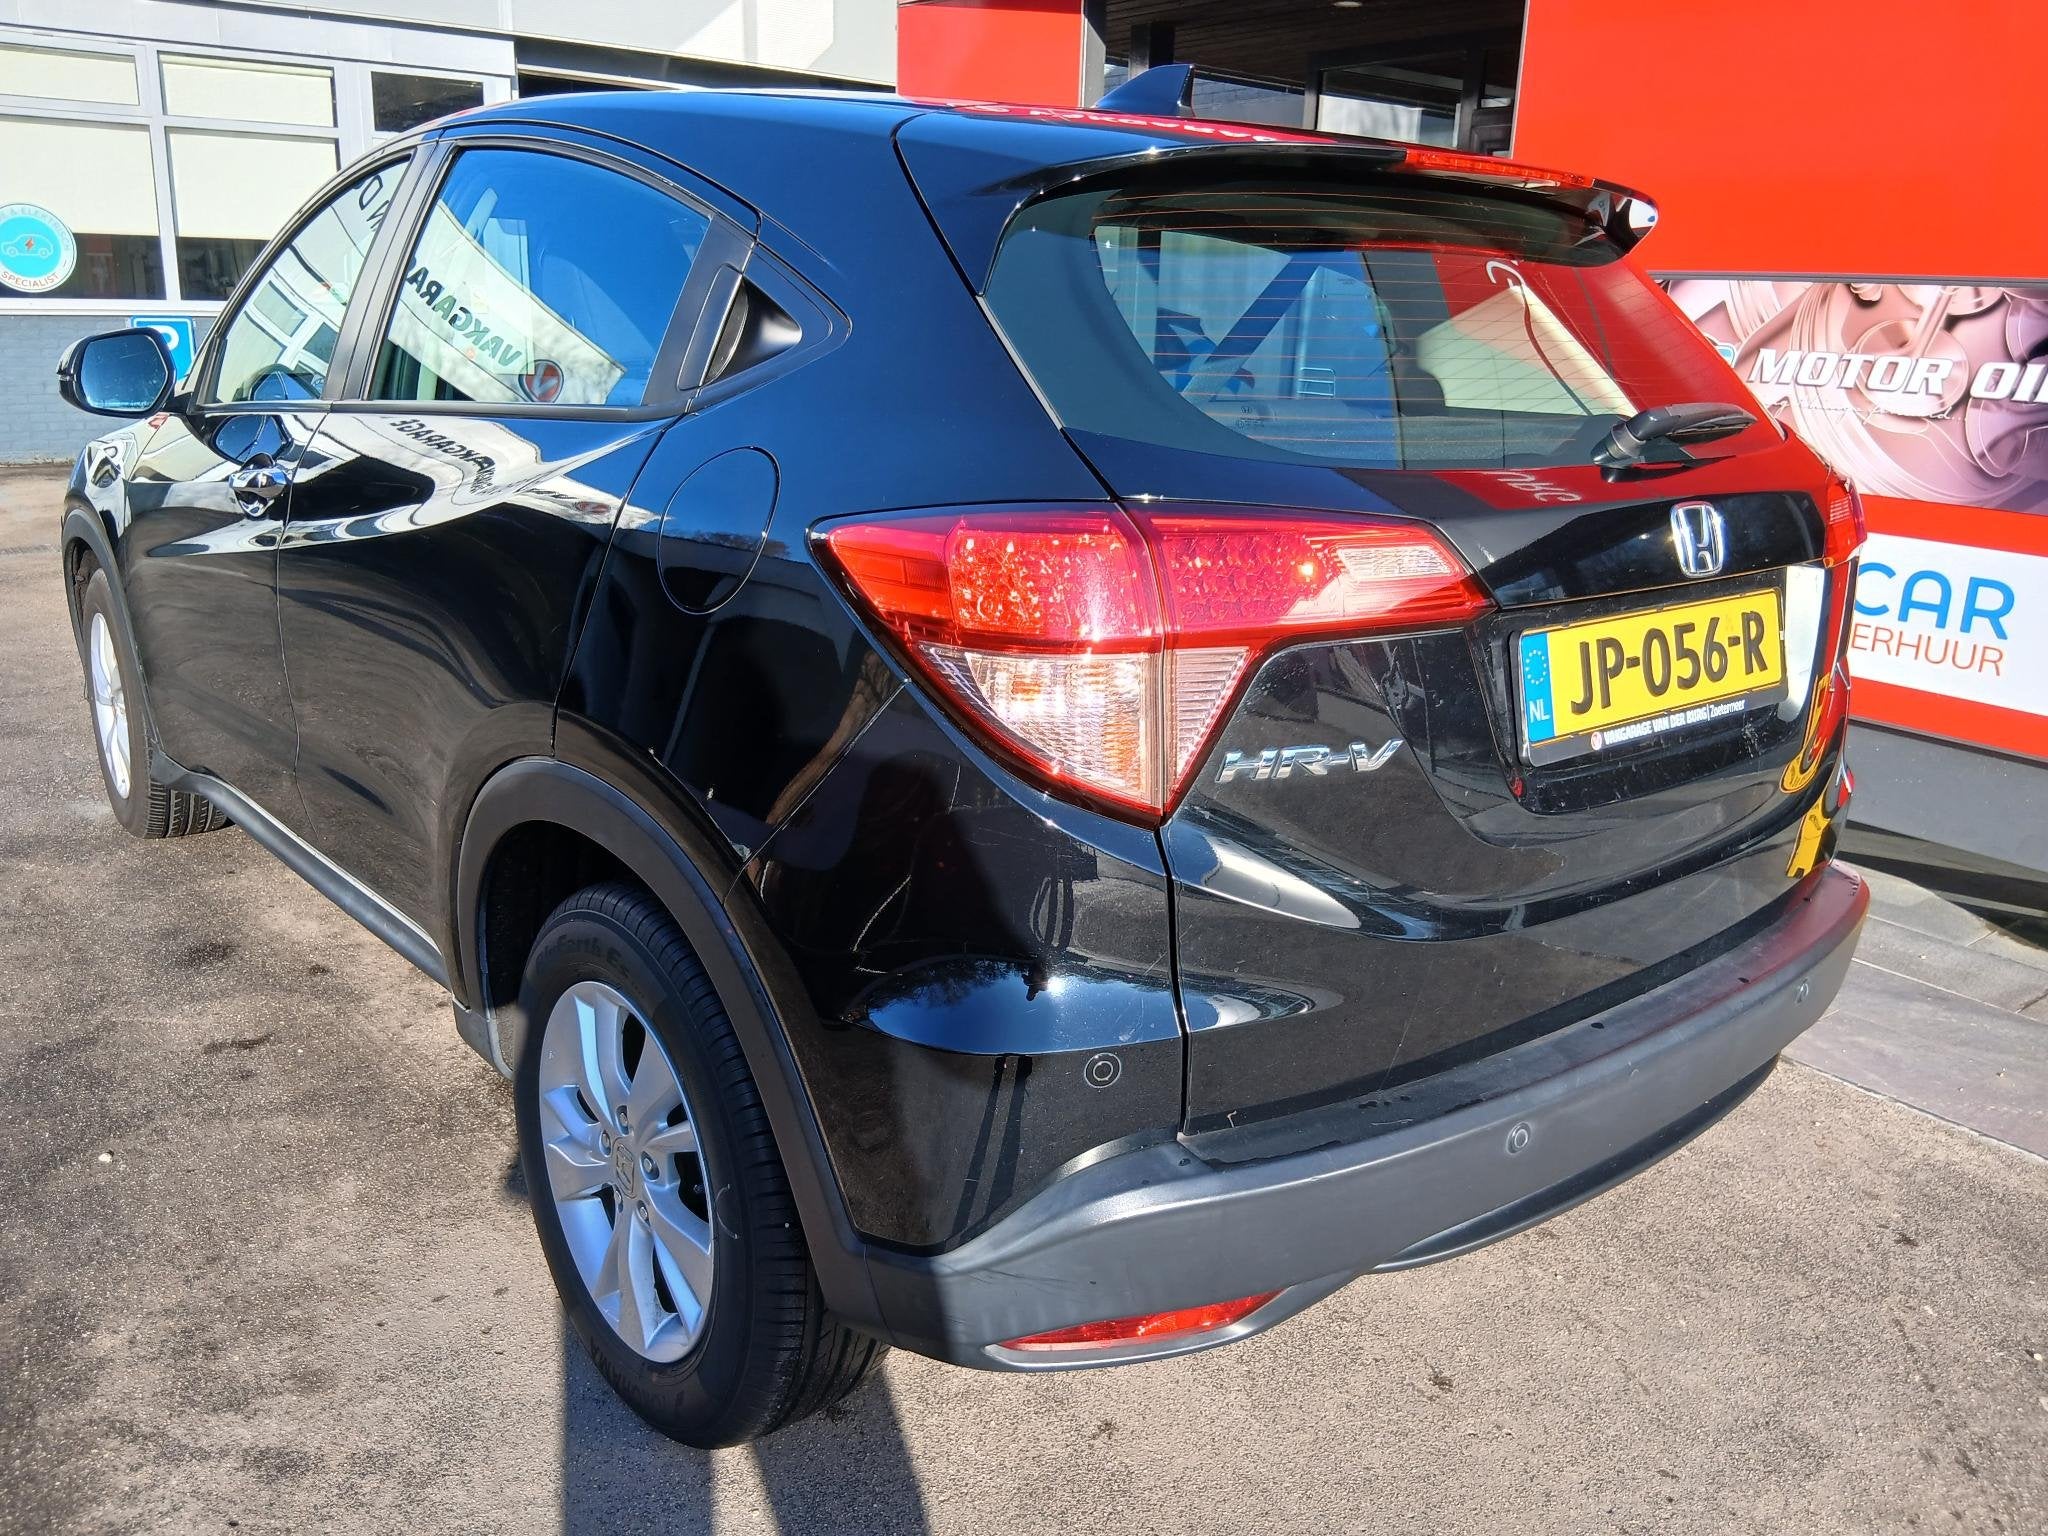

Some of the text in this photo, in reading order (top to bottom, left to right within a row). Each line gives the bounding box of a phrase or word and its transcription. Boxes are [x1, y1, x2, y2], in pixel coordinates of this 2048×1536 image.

[1, 271, 60, 289] SPECIALIST
[1747, 348, 1954, 396] MOTOR
[1854, 562, 2015, 640] CAR
[1570, 610, 1768, 716] JP-056-R
[1529, 699, 1550, 724] NL
[1653, 715, 1670, 733] VAN
[1670, 712, 1686, 728] DER
[1687, 706, 1707, 724] BURG
[1710, 699, 1746, 718] Zoetermeer
[1214, 737, 1405, 783] HR-V
